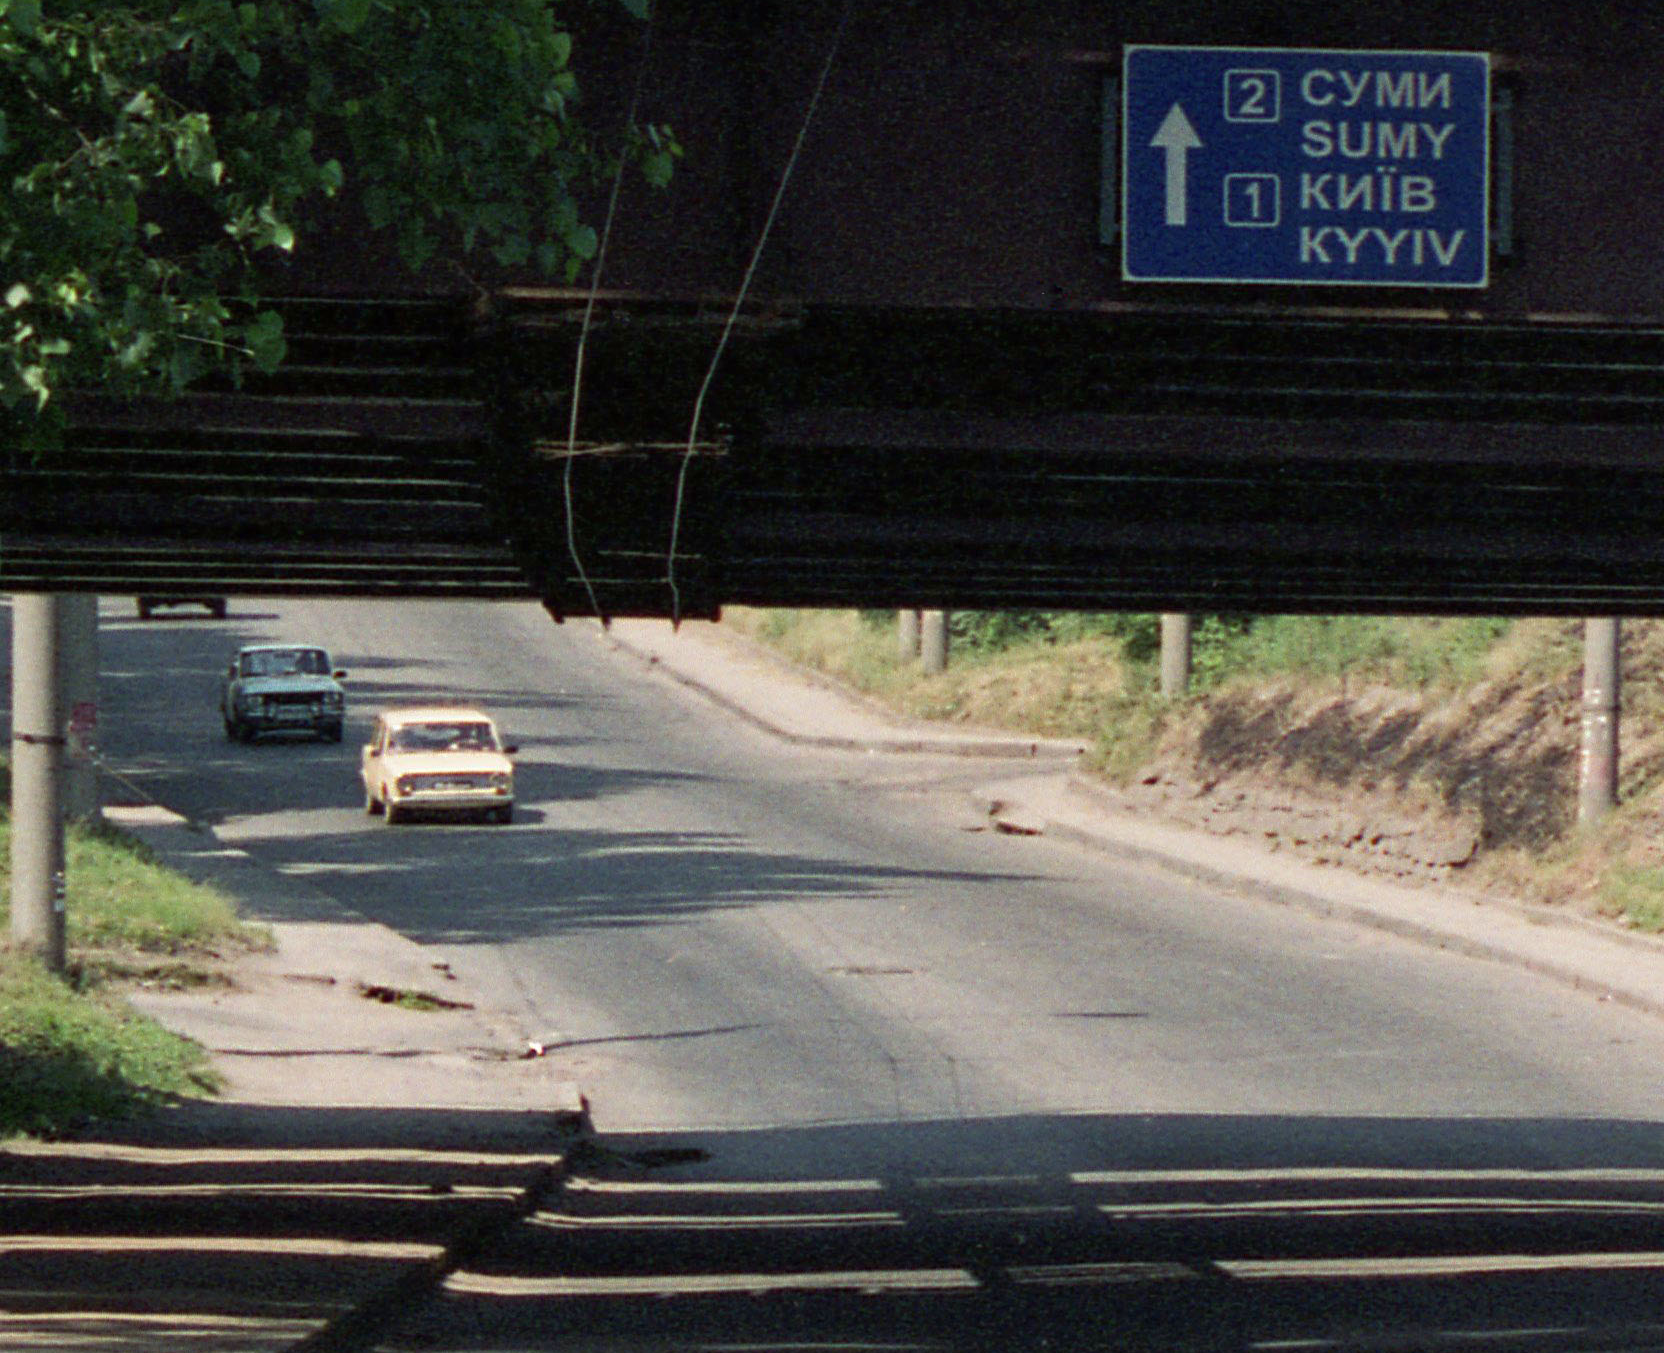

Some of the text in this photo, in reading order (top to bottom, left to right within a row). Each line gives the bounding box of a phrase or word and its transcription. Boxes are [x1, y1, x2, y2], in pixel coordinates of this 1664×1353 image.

[1239, 69, 1453, 115] 2 СУМИ
[1300, 119, 1457, 161] SUMY
[1245, 165, 1438, 219] 1 КИЇВ
[1300, 226, 1467, 267] KYYIV
